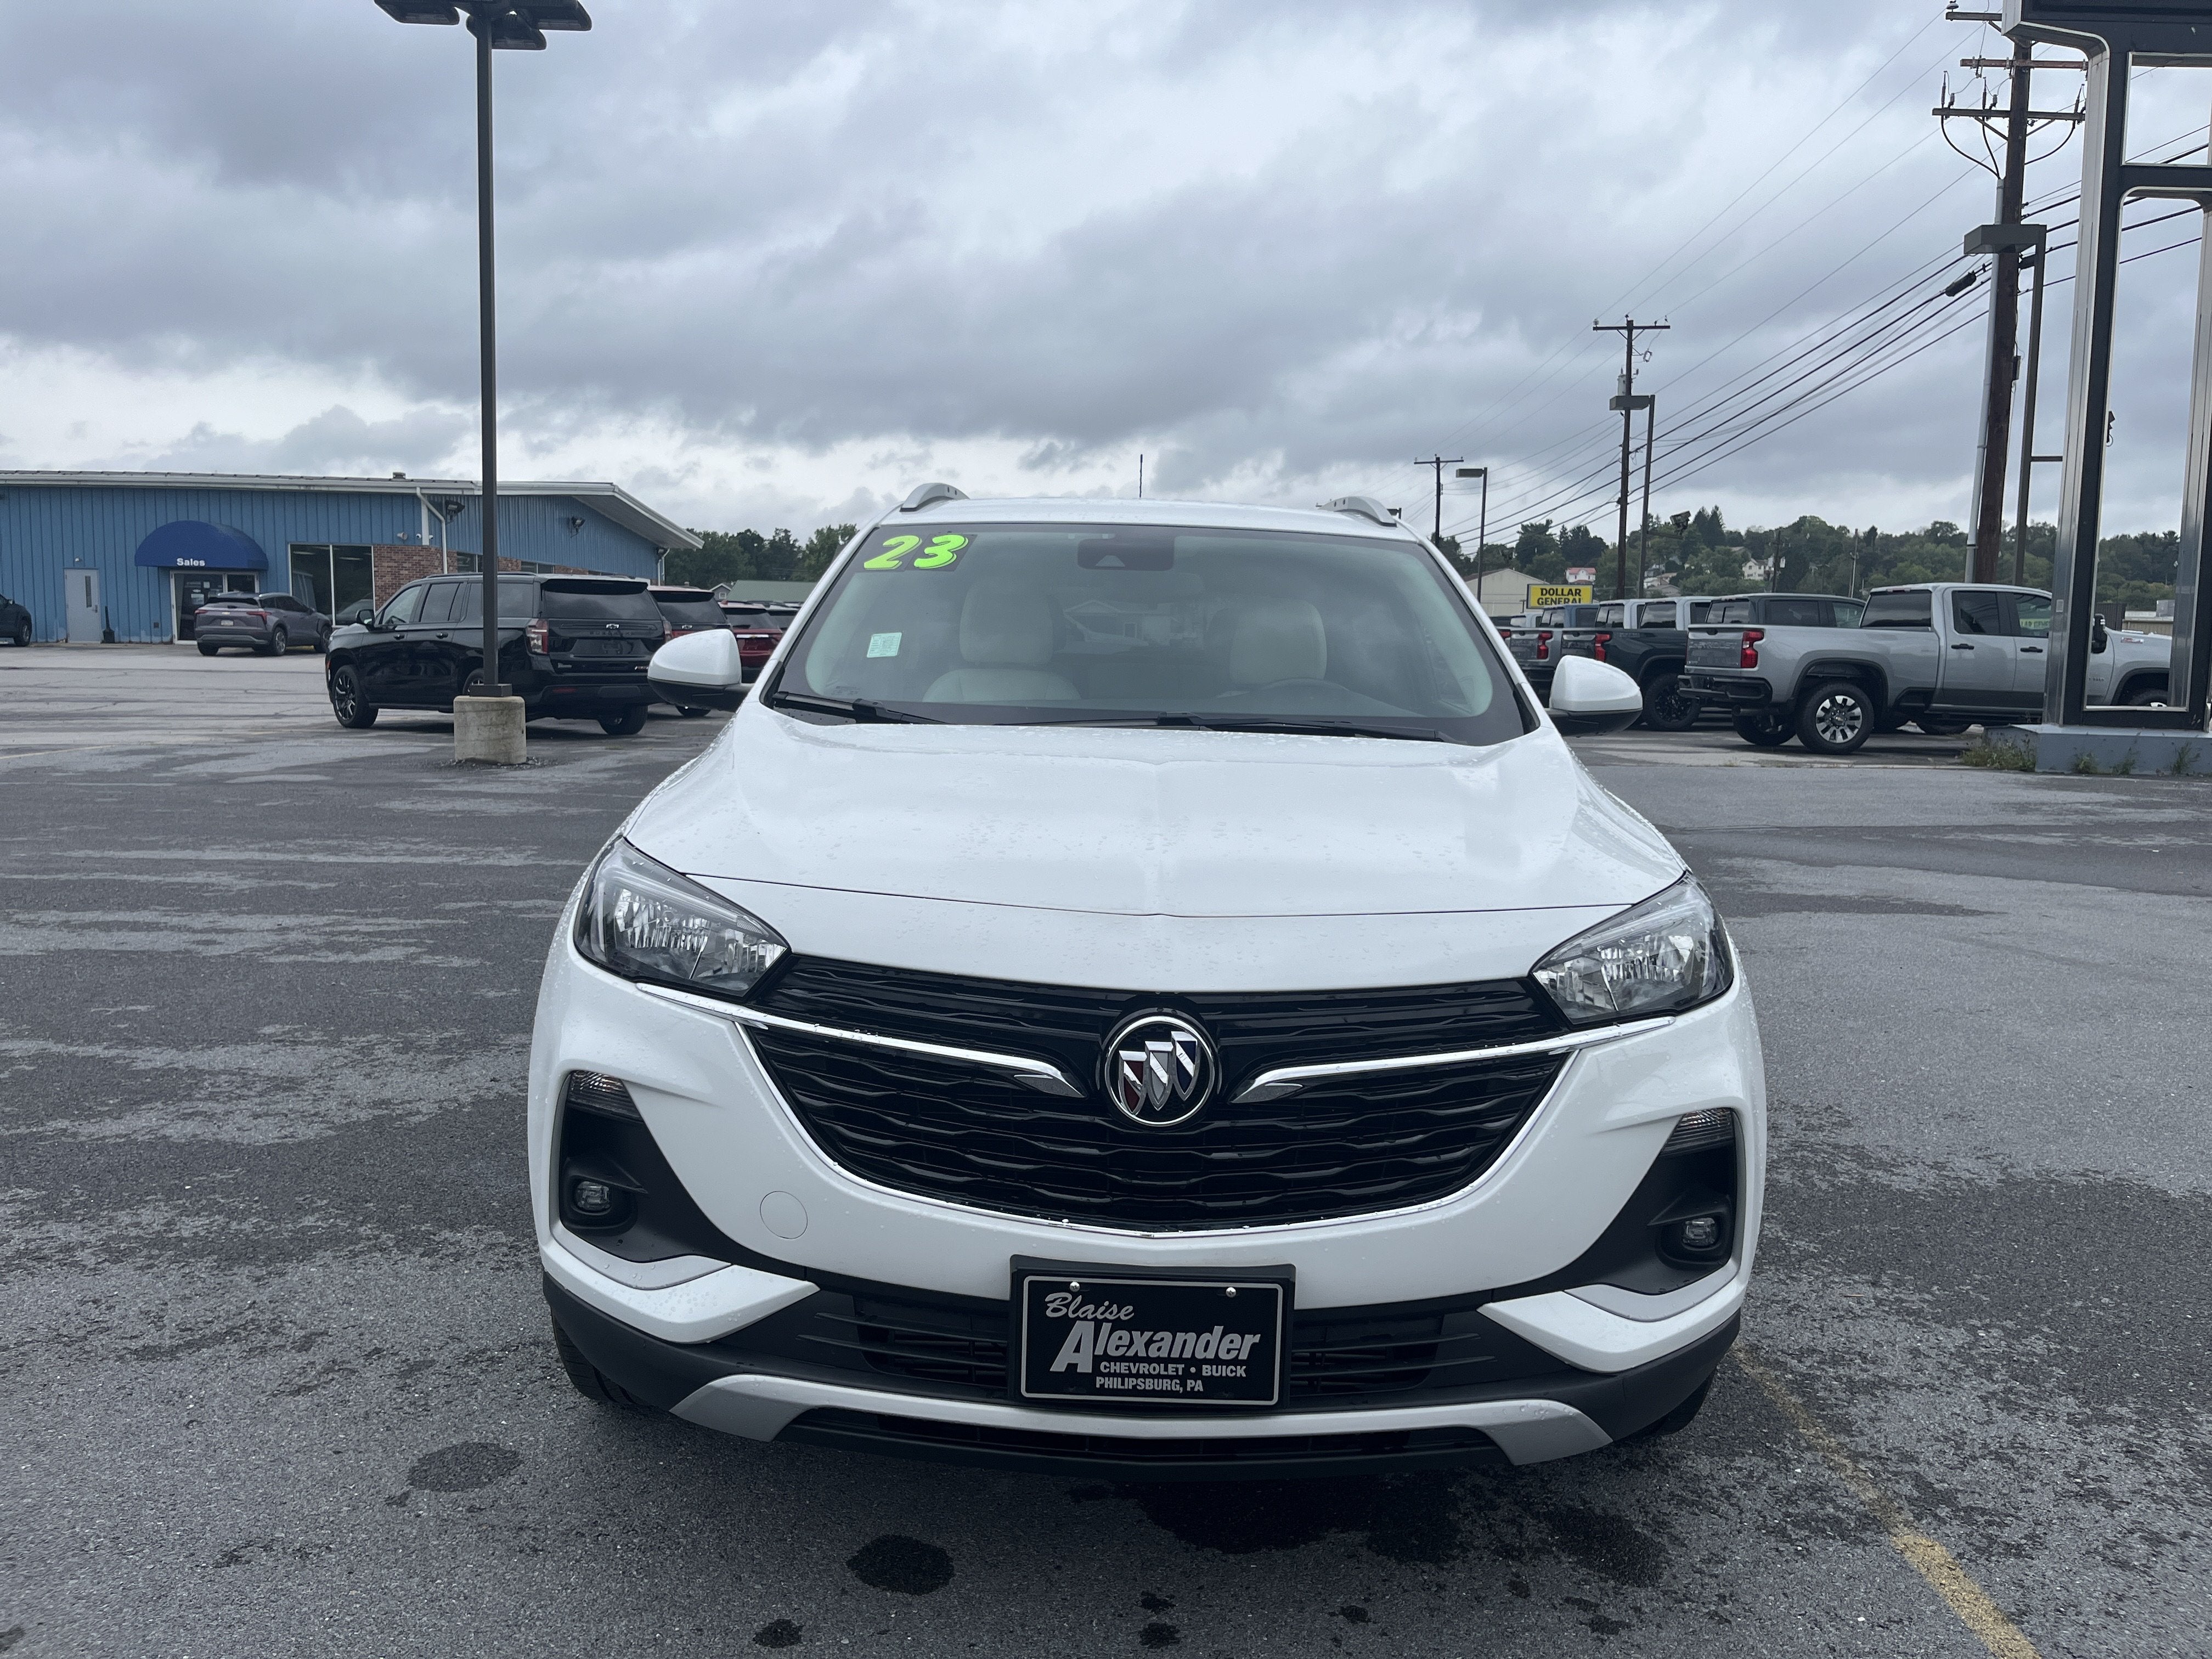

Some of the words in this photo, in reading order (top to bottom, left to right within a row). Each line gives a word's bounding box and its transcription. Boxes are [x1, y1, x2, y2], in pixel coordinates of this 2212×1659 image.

[864, 534, 969, 570] 23
[177, 557, 205, 566] Sales
[1541, 588, 1582, 596] DOLLAR
[1045, 1292, 1135, 1320] Blaise
[1050, 1321, 1261, 1373] Alexander
[1100, 1361, 1185, 1375] CHEVROLET
[1203, 1364, 1246, 1378] BUICK
[1096, 1376, 1183, 1393] PHILIPSBURG,
[1187, 1379, 1204, 1392] PA
